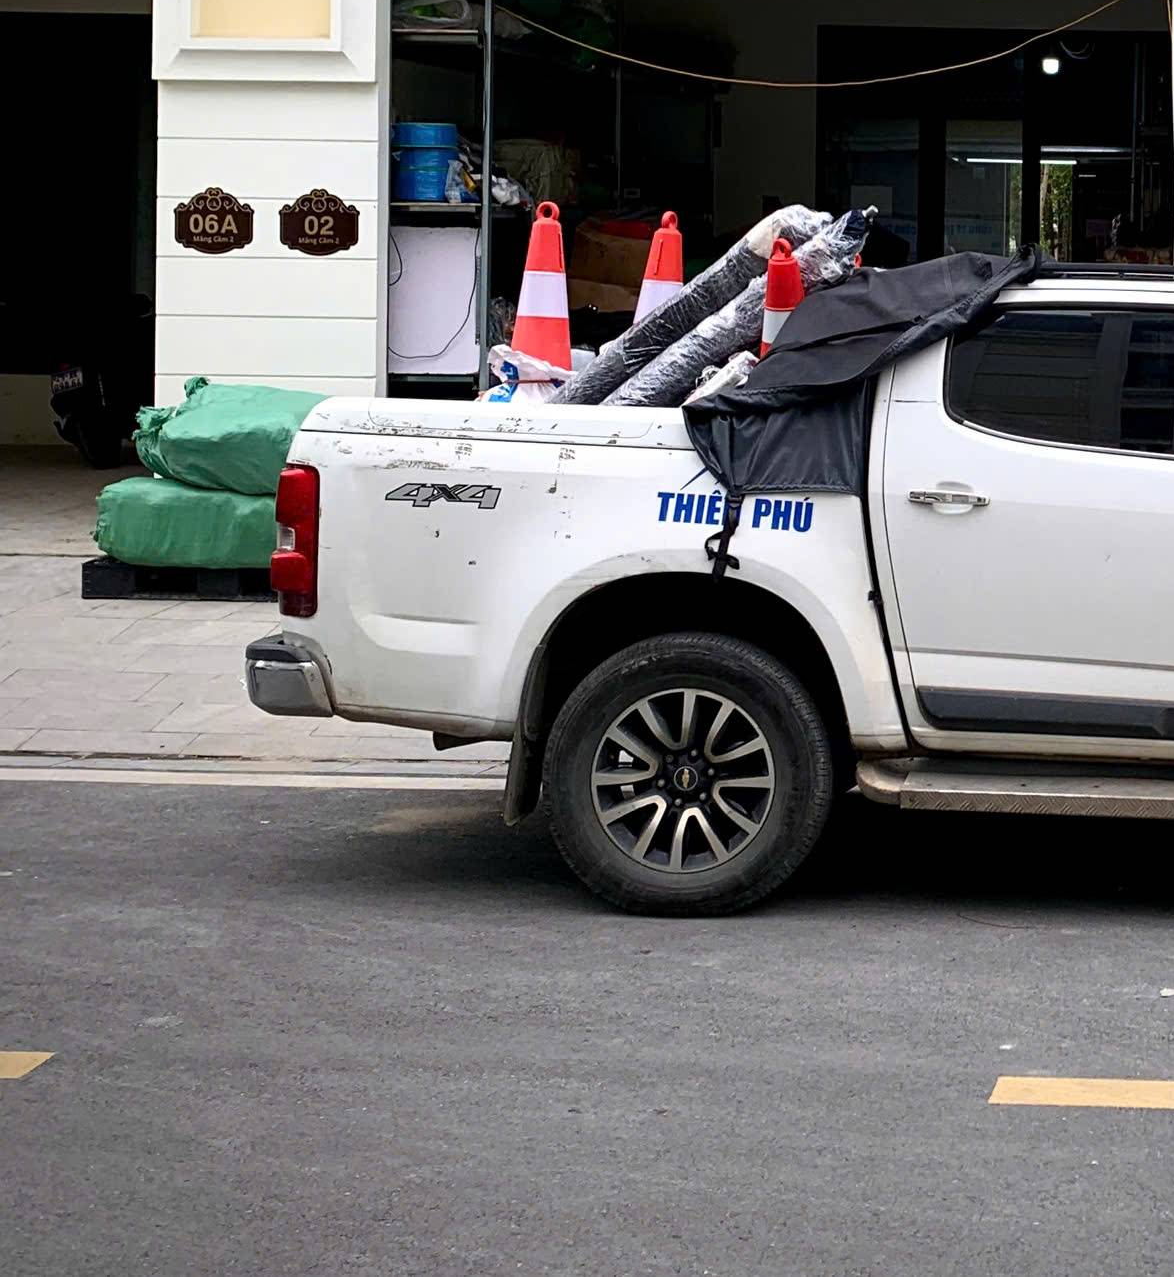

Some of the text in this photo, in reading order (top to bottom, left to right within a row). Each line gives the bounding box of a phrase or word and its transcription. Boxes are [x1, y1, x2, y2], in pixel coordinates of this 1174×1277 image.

[189, 213, 239, 234] 06A
[304, 215, 335, 236] 02
[657, 489, 814, 533] THIÊ PHÚ
